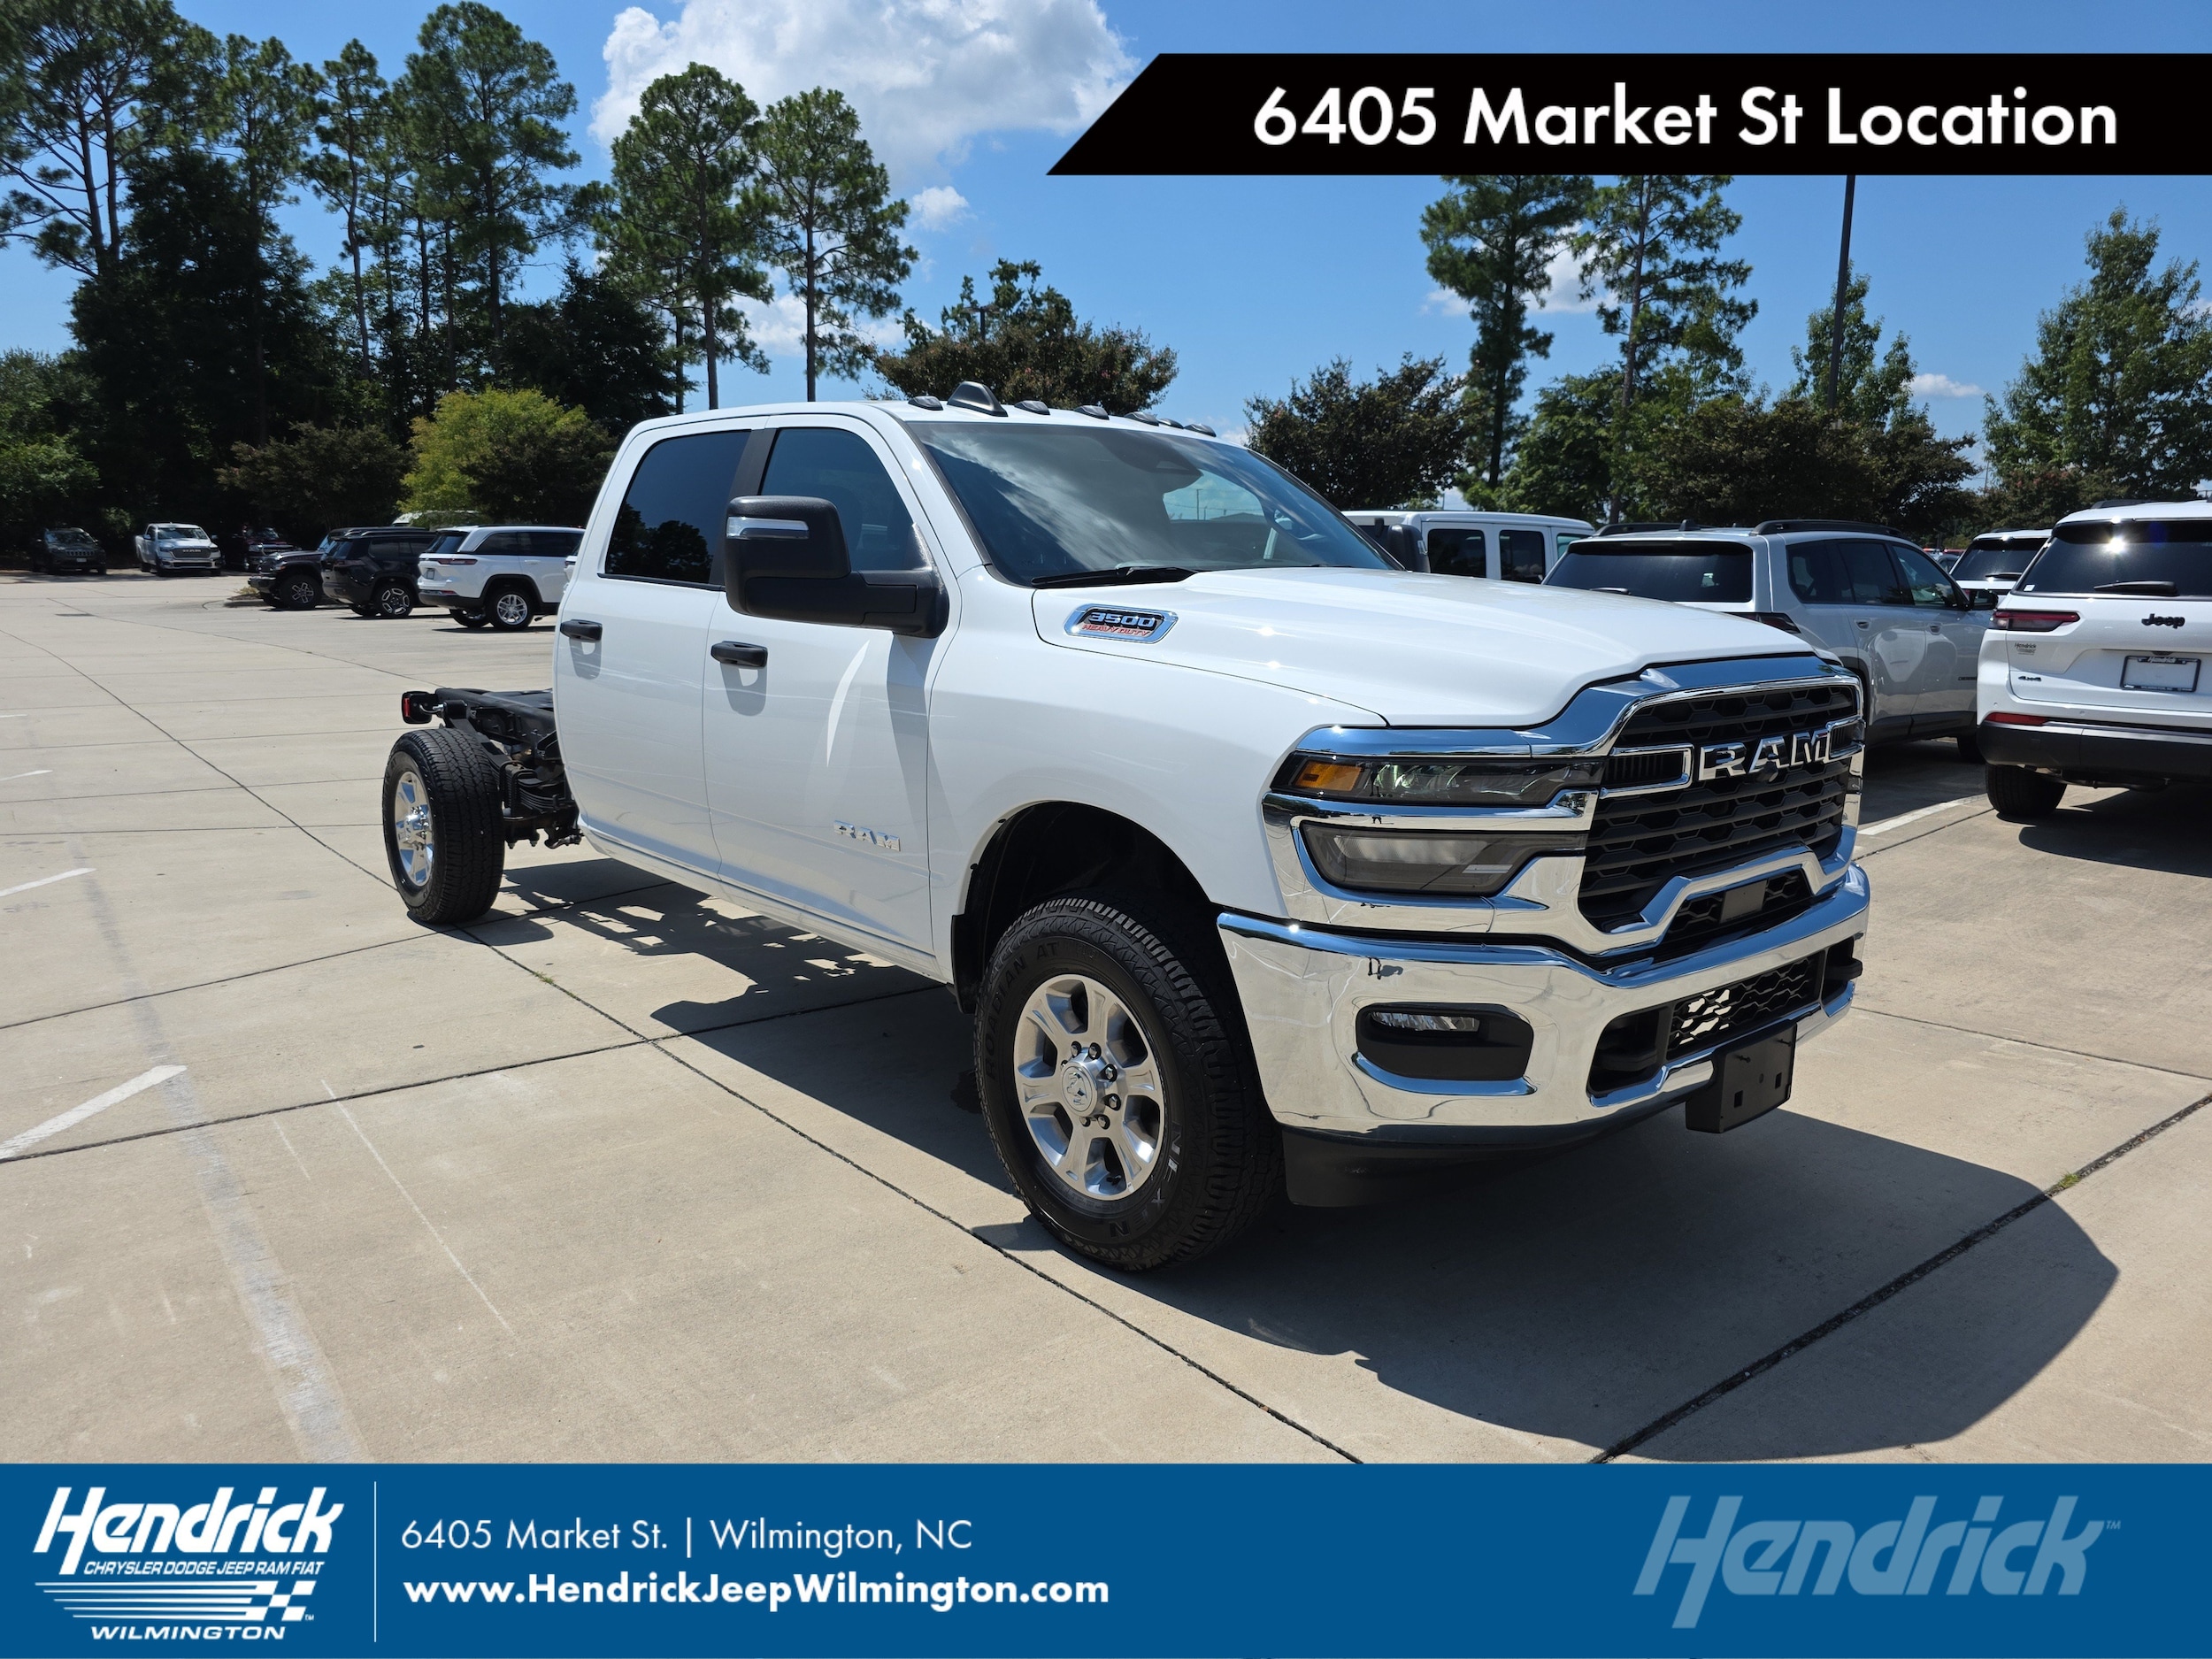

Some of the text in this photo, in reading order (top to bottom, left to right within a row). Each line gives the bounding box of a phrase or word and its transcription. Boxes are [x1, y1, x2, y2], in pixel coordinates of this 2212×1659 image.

[1082, 623, 1119, 632] HEAVY
[1088, 612, 1156, 627] 3500
[2141, 613, 2185, 629] Jeep
[1699, 728, 1831, 781] RAM
[833, 819, 902, 852] RAM
[985, 956, 1028, 1081] ROADIAN
[1036, 941, 1060, 961] AT
